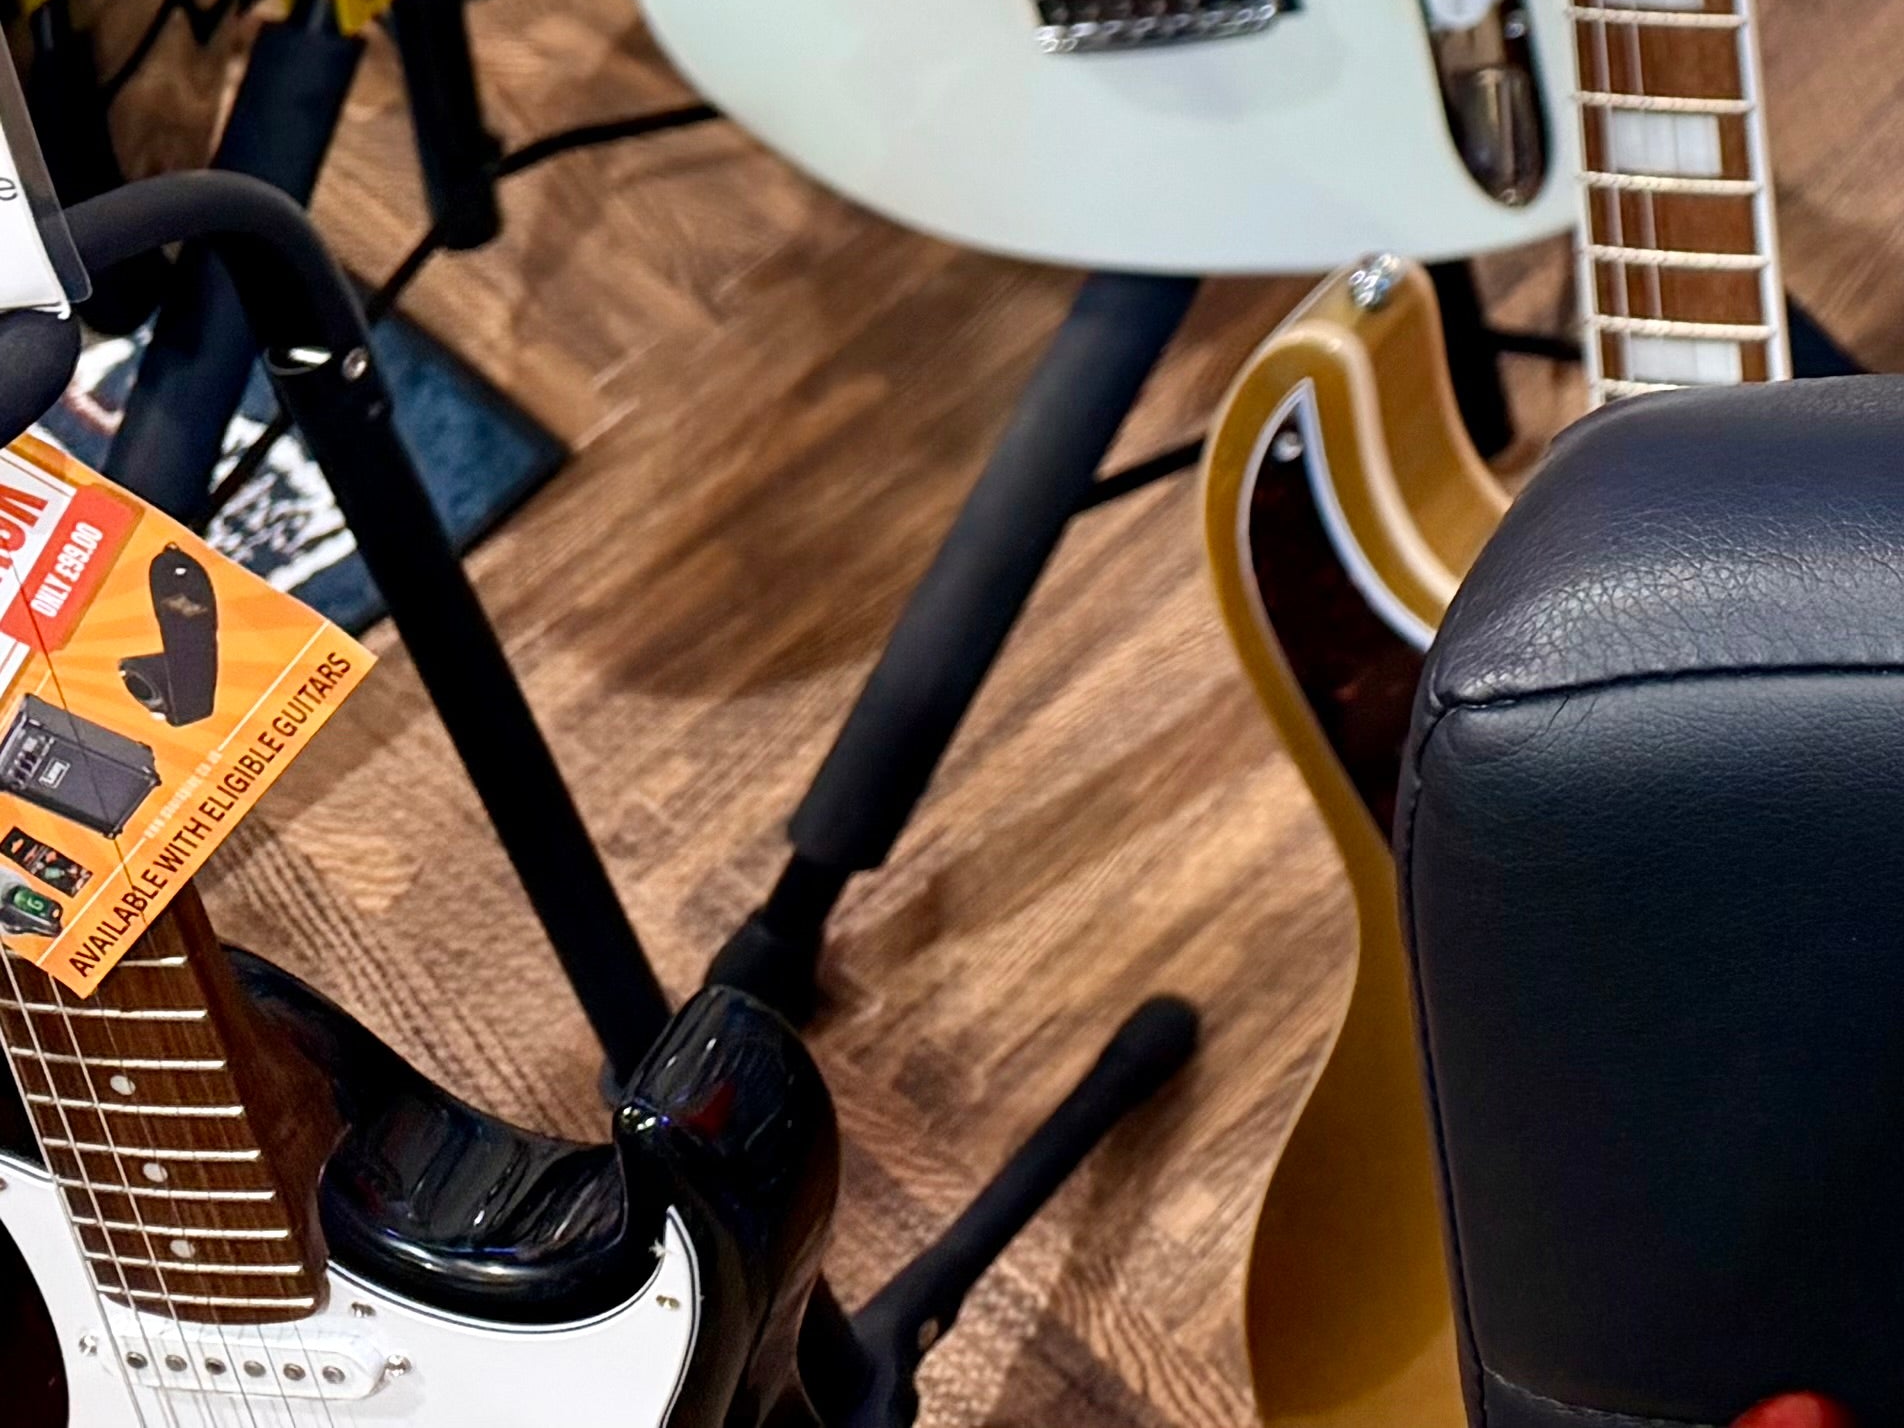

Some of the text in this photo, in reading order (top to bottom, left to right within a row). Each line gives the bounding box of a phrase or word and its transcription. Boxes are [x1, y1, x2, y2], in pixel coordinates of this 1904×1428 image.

[30, 521, 104, 619] ONLY £99.00
[68, 869, 169, 978] AVAILABLE
[154, 815, 213, 876] WITH
[199, 730, 285, 823] ELIGIBLE
[271, 650, 352, 738] GUITARS
